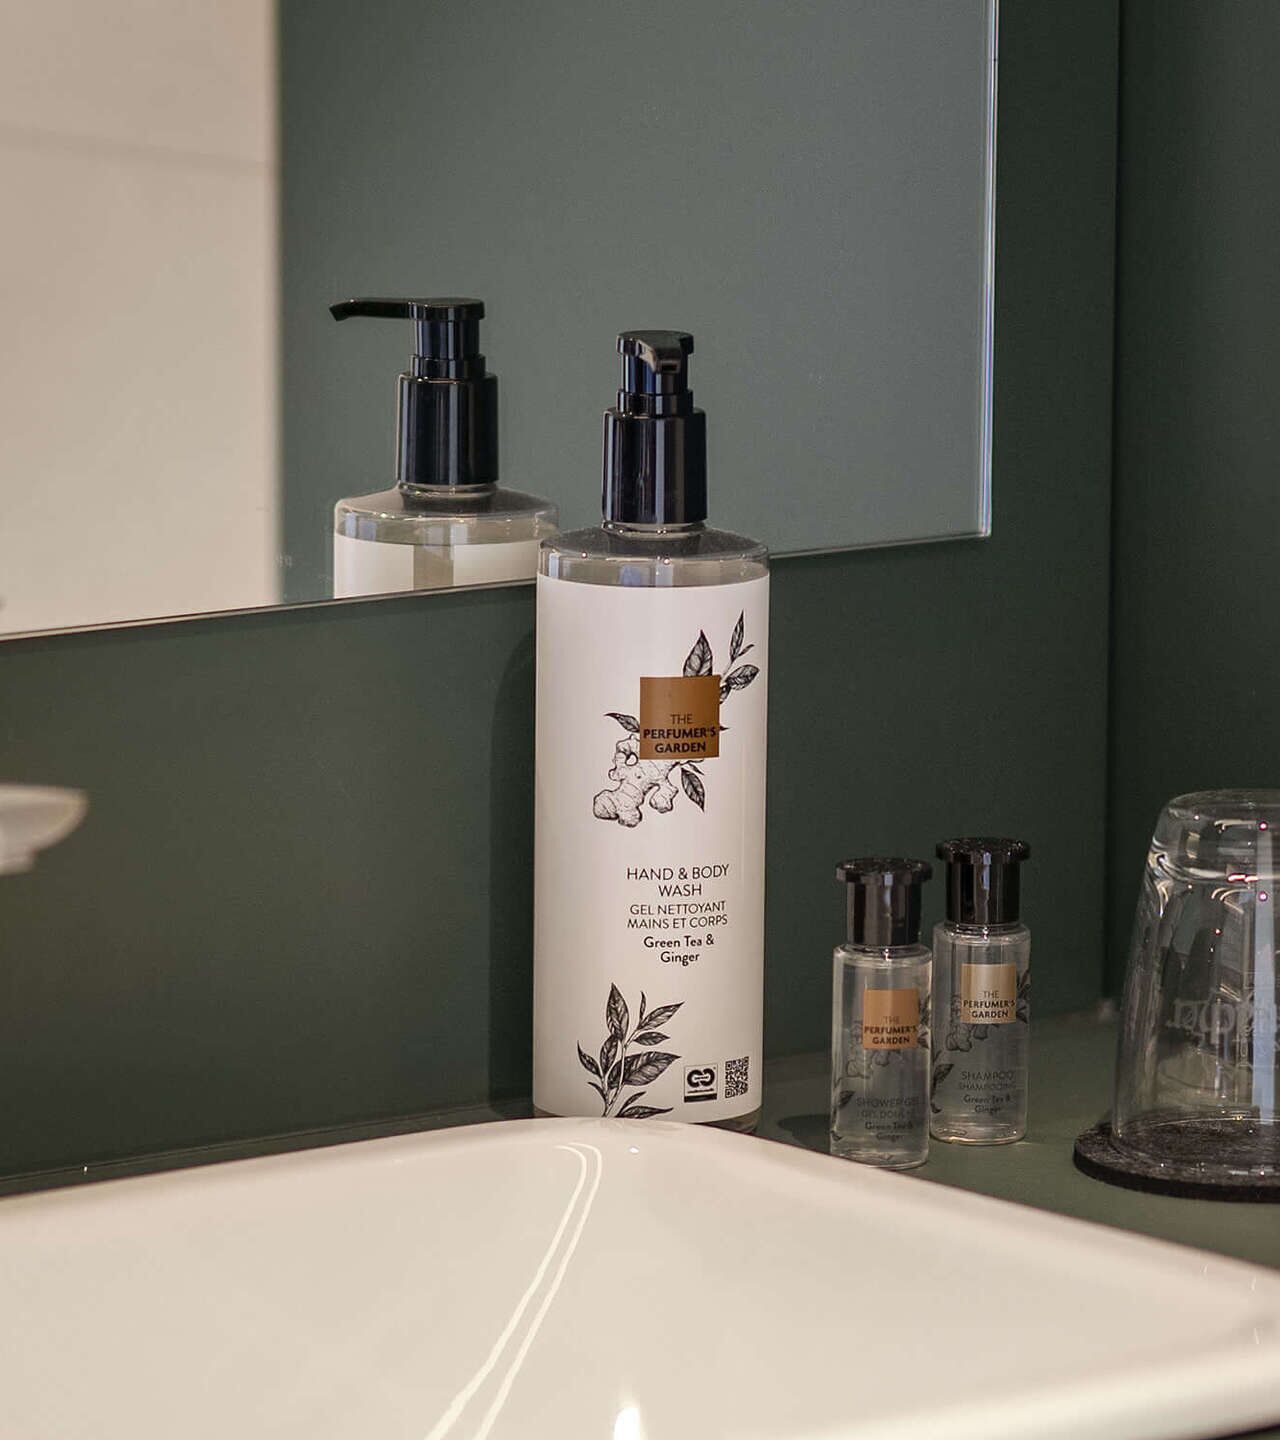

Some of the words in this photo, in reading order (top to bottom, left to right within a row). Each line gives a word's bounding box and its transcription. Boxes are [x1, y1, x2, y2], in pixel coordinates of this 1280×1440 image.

[670, 714, 693, 725] THE
[643, 726, 717, 740] PERFUMER'S
[654, 741, 707, 754] GARDEN
[626, 867, 674, 881] HAND
[678, 867, 688, 880] &
[692, 864, 730, 880] BODY
[658, 884, 702, 897] WASH
[630, 904, 654, 915] GEL
[657, 900, 727, 915] NETTOYANT
[627, 918, 670, 929] MAINS
[673, 918, 687, 929] ET
[689, 914, 728, 928] CORPS
[643, 936, 681, 948] Green
[684, 935, 702, 947] Tea
[706, 933, 715, 945] &
[660, 951, 700, 967] Ginger
[983, 990, 1000, 999] THE
[963, 1000, 1016, 1009] PERFUMER'S
[971, 1010, 1009, 1019] GARDEN
[872, 1037, 910, 1045] GARDEN
